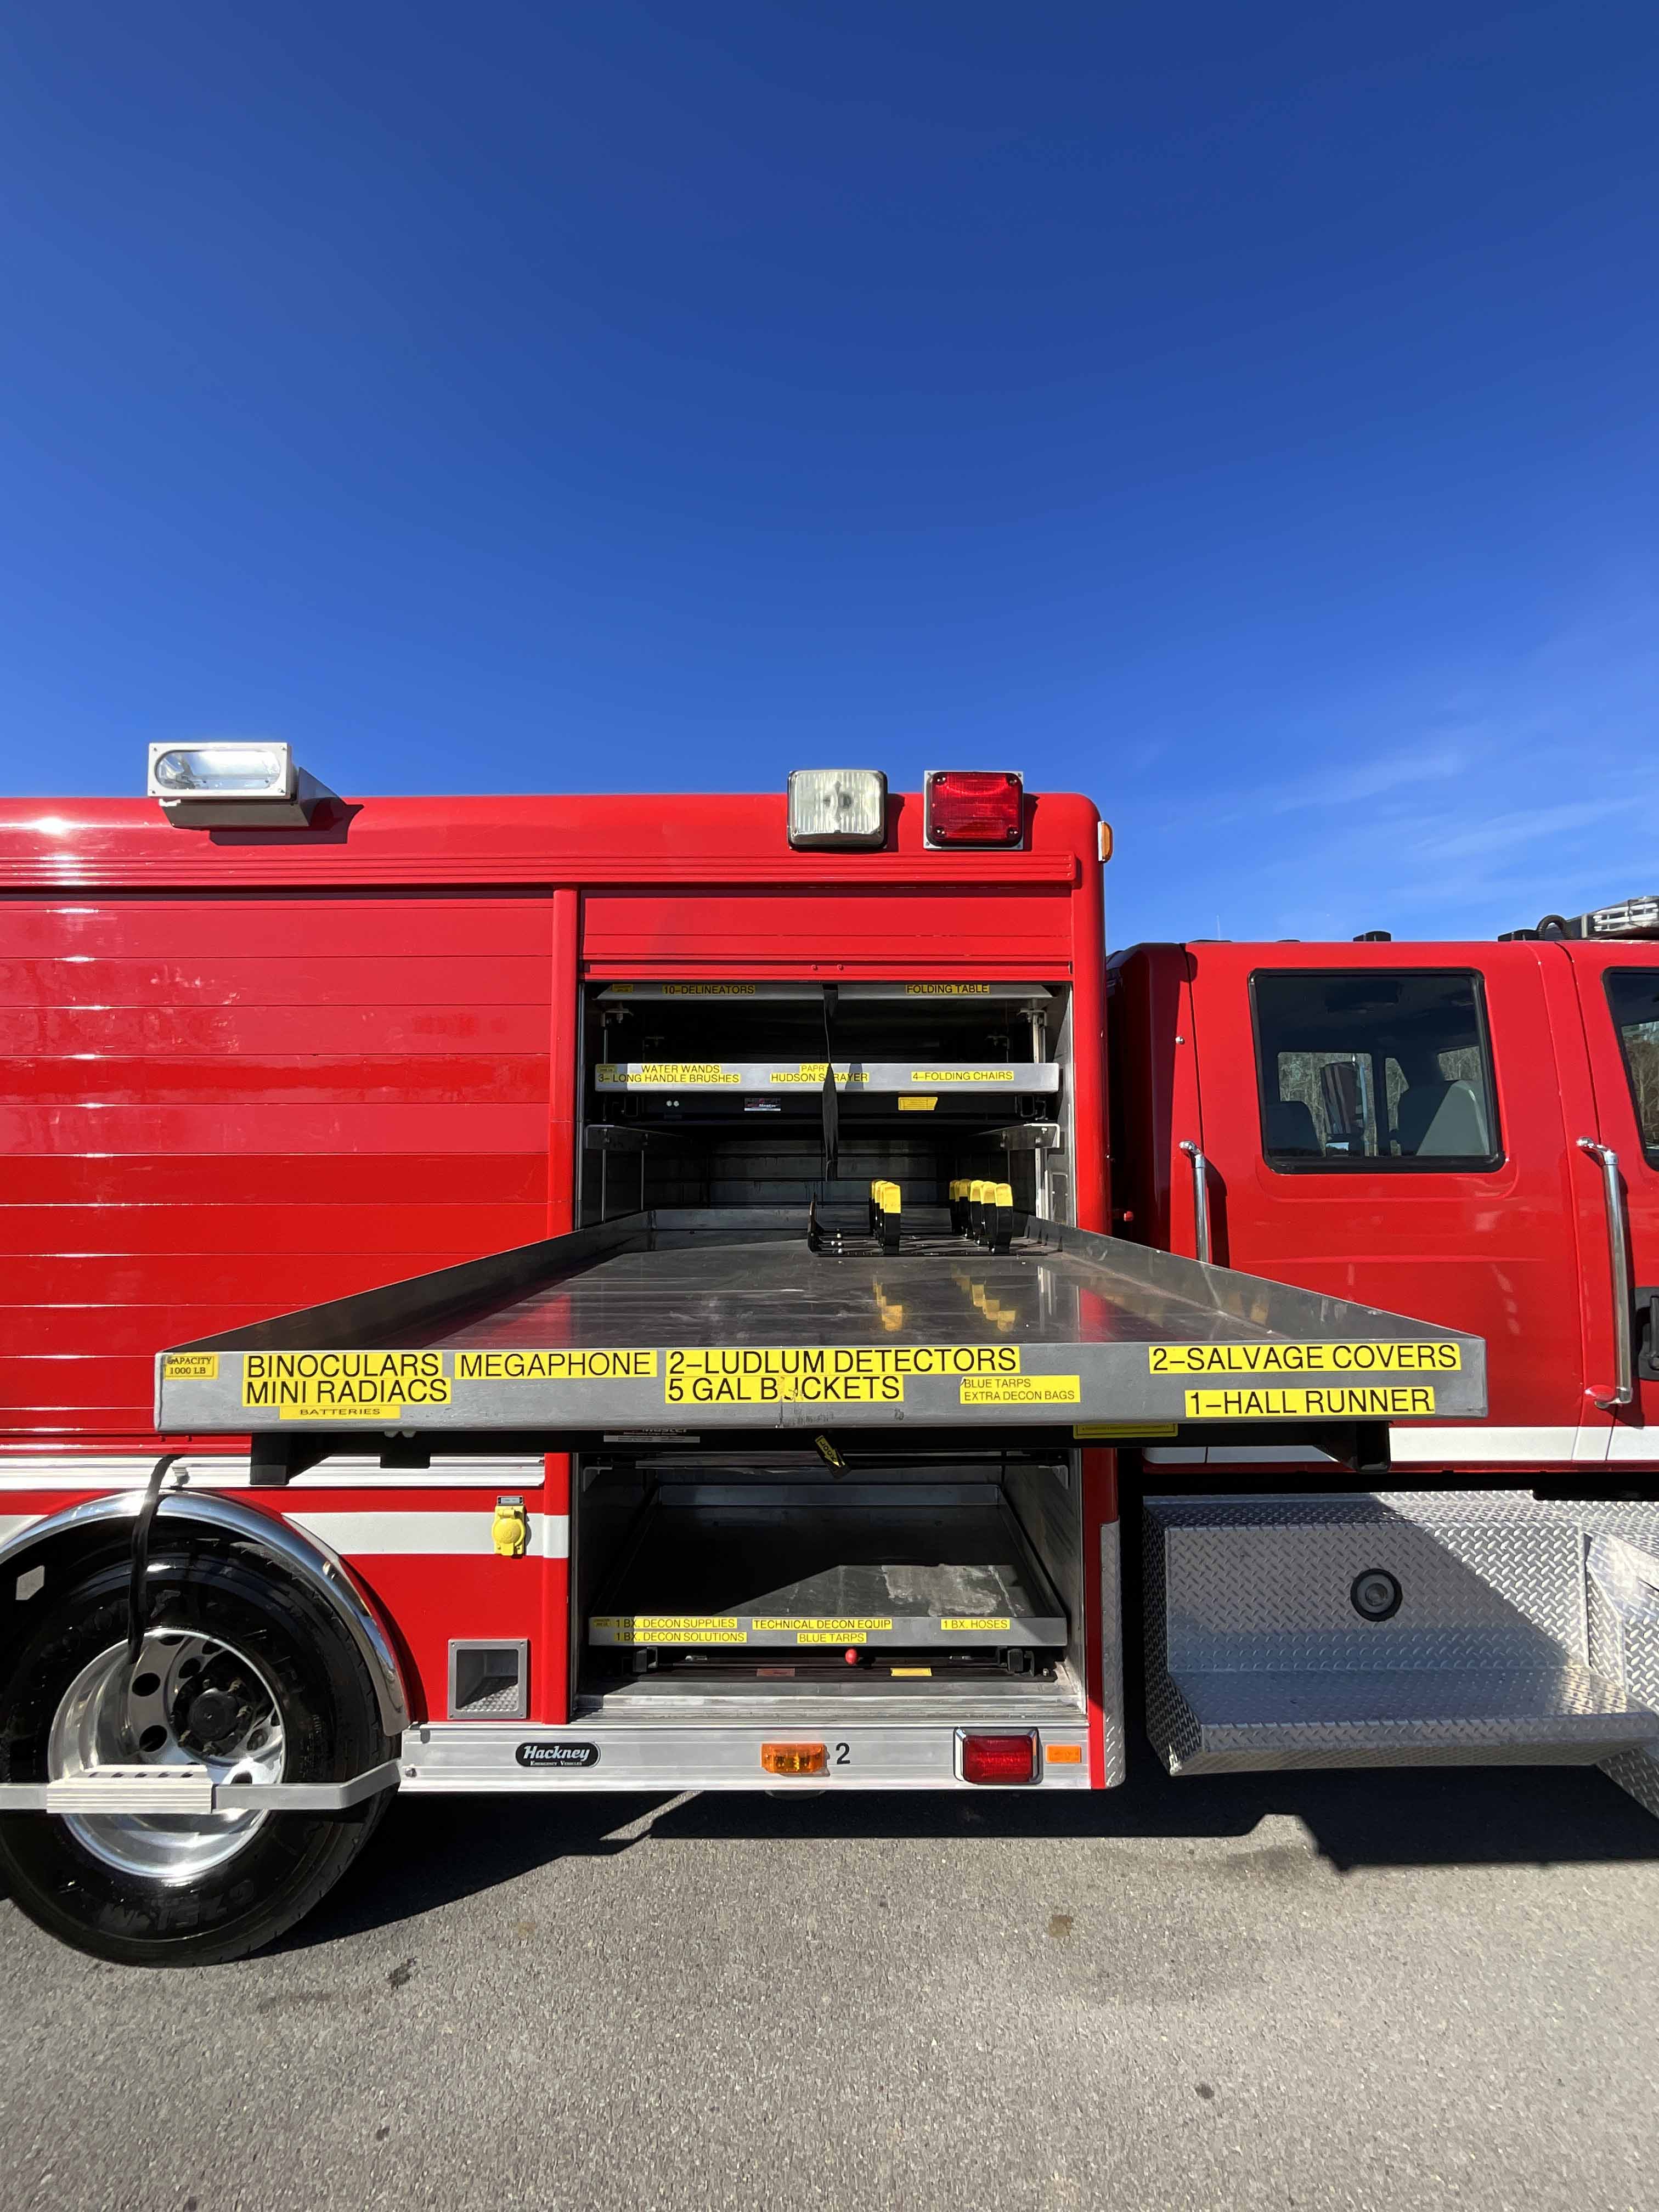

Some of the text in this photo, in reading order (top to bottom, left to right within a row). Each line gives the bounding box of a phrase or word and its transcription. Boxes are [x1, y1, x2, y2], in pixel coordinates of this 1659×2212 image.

[907, 984, 988, 994] FOLDING TABLE
[641, 1065, 720, 1074] WATER WANDS
[613, 1074, 642, 1082] LONG
[645, 1074, 686, 1083] HANDLE
[689, 1074, 740, 1083] BRUSHES
[771, 1073, 868, 1082] HUDSON SRAYER
[913, 1071, 1013, 1080] 4-FOLDING CHAIRS
[669, 1348, 1017, 1374] 2-LUDLUM DETECTORS
[1153, 1344, 1457, 1371] 2-SALVAGE COVERS
[248, 1353, 439, 1378] BINOCULARS
[460, 1353, 652, 1376] MEGAPHONE
[964, 1378, 1031, 1388] BLUE TARPS
[247, 1378, 448, 1404] MINI RADIACS
[669, 1378, 683, 1402] 5
[693, 1376, 752, 1400] GAL
[964, 1390, 1075, 1401] EXTRA DECON BAGS
[1189, 1388, 1434, 1415] 1-HALL RUNNER
[616, 1620, 620, 1628] 1
[623, 1619, 640, 1628] BX.
[644, 1619, 681, 1628] DECON
[684, 1619, 735, 1628] SUPPLIES
[754, 1620, 891, 1629] TECHNICAL DECON EQUIP
[951, 1620, 968, 1628] BX.
[972, 1620, 1008, 1628] HOSES
[616, 1633, 744, 1641] 1 BX. DECON SOLUTIONS
[799, 1633, 864, 1642] BLUE TARPS
[523, 1745, 590, 1762] Hackney
[836, 1742, 851, 1765] 2
